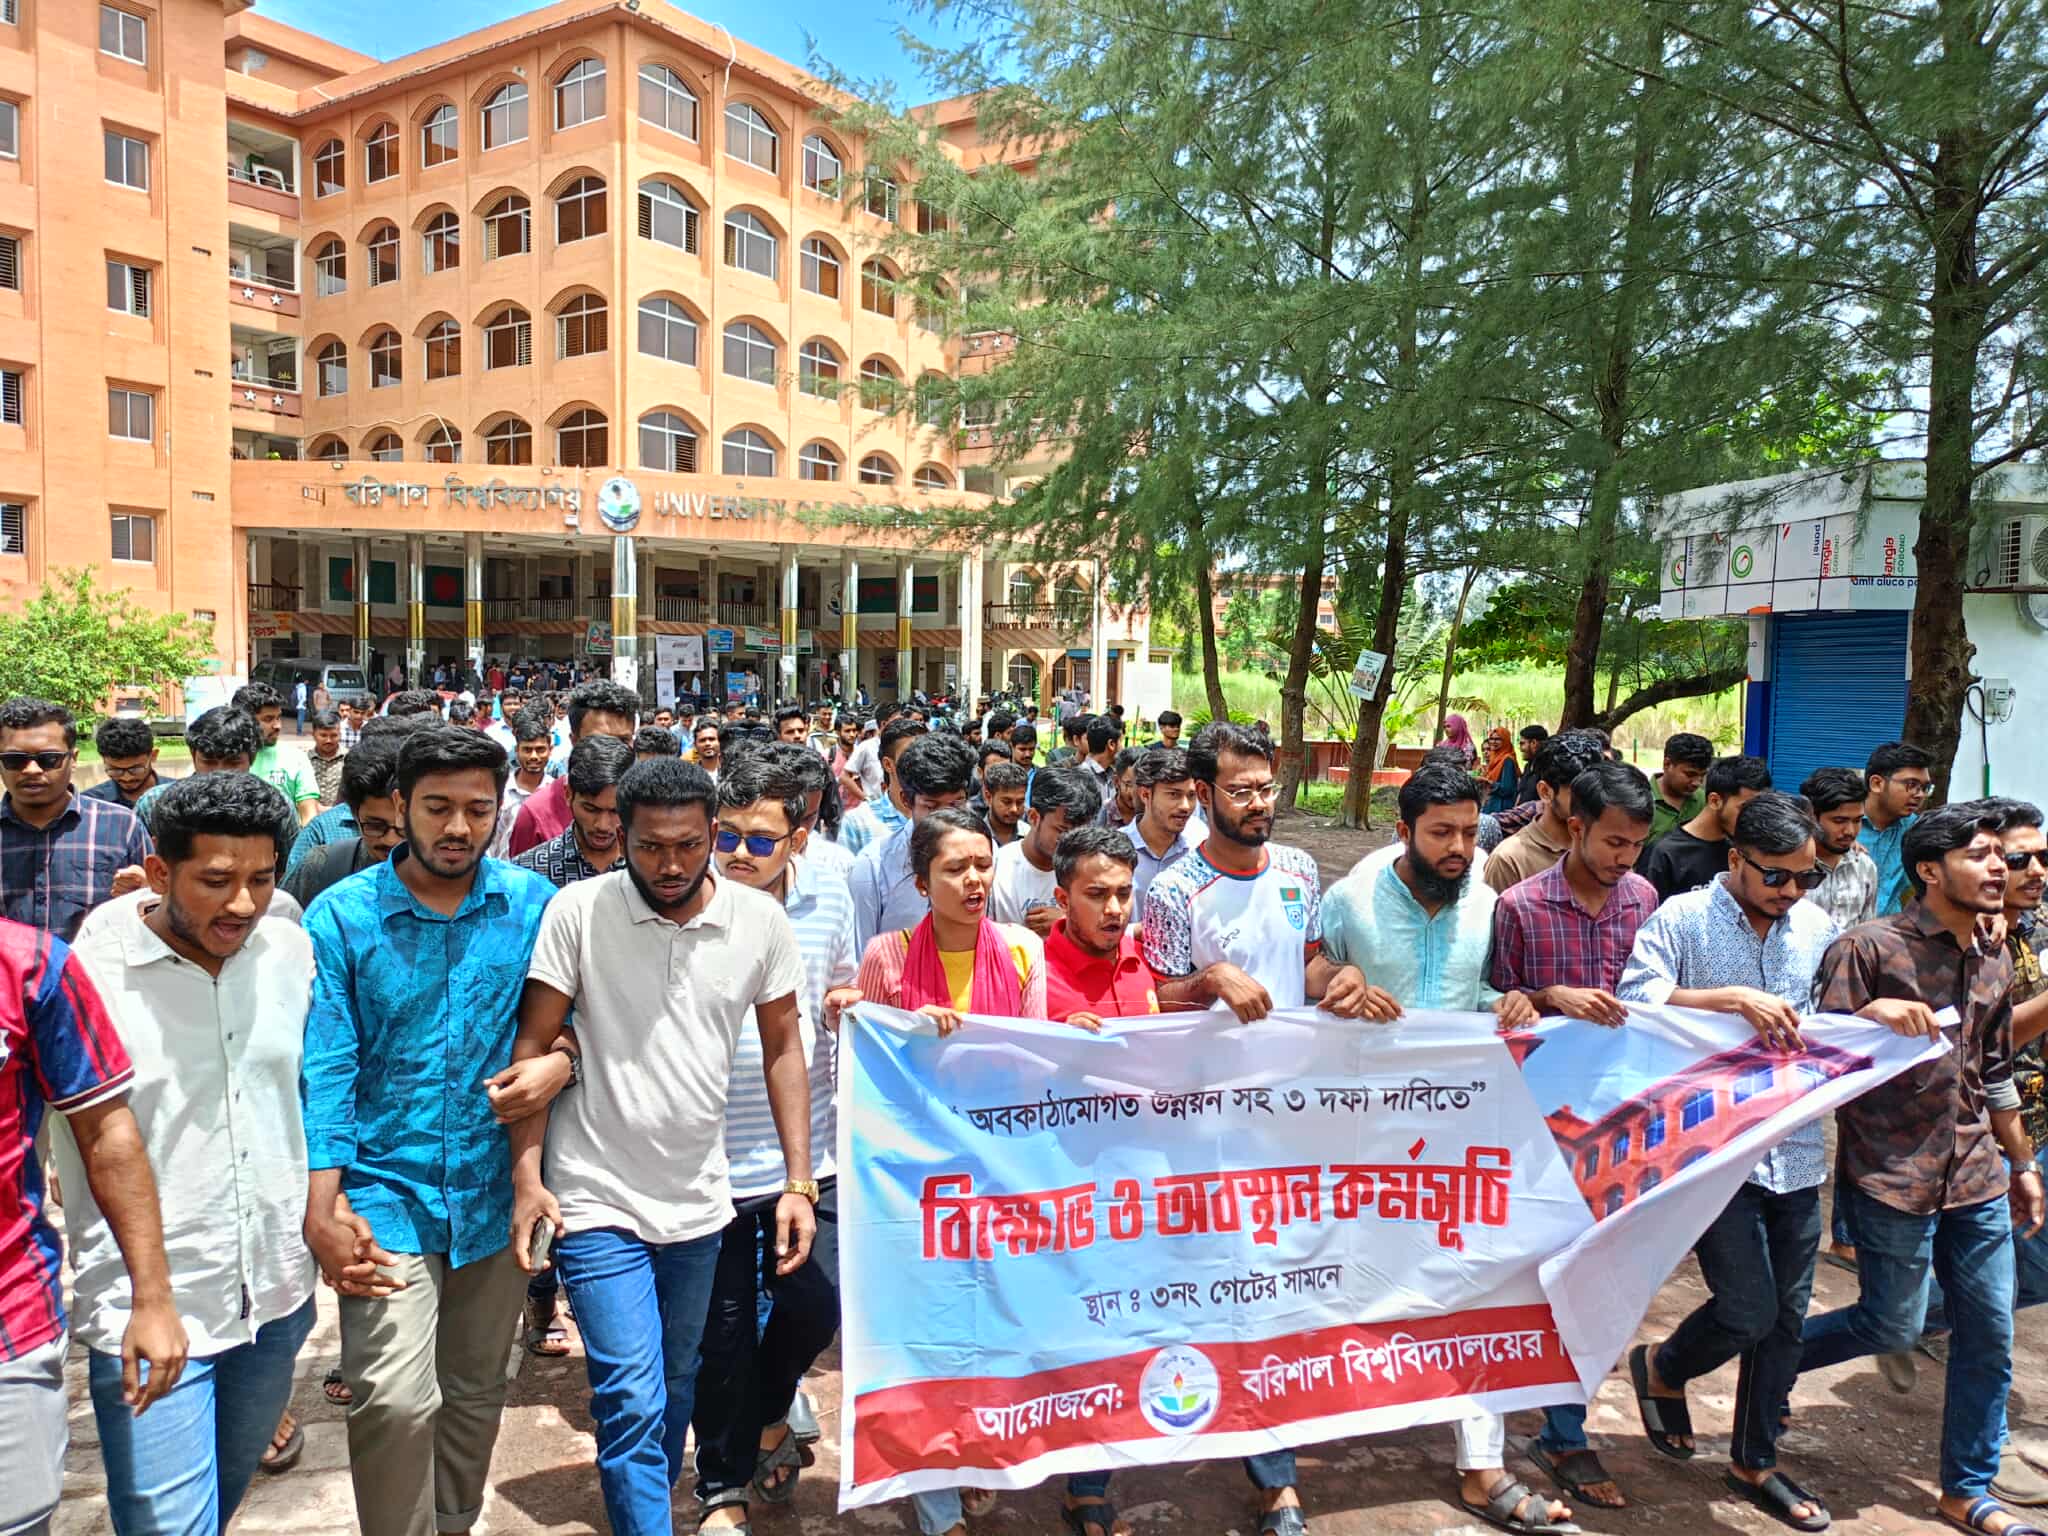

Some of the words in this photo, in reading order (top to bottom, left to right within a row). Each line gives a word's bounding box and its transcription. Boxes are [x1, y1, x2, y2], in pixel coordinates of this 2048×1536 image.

[344, 475, 429, 507] বরিশাল
[1823, 538, 1833, 577] angla
[1883, 536, 1897, 577] angla
[1149, 1089, 1225, 1121] উন্নয়ন
[1231, 1087, 1275, 1115] সহ
[1283, 1089, 1306, 1112] ৩
[1314, 1085, 1373, 1113] দফা
[920, 1173, 1097, 1261] বিক্ষোভ
[1108, 1178, 1144, 1241] ও
[1153, 1164, 1322, 1247] অবস্থান
[1328, 1136, 1513, 1253] কর্মসূচি
[1150, 1282, 1202, 1309] ৩নং
[1210, 1270, 1278, 1306] গেটের
[1281, 1264, 1343, 1295] সামনে
[1239, 1354, 1335, 1403] বরিশাল
[1340, 1331, 1545, 1385] বিশ্ববিদ্যালয়ের
